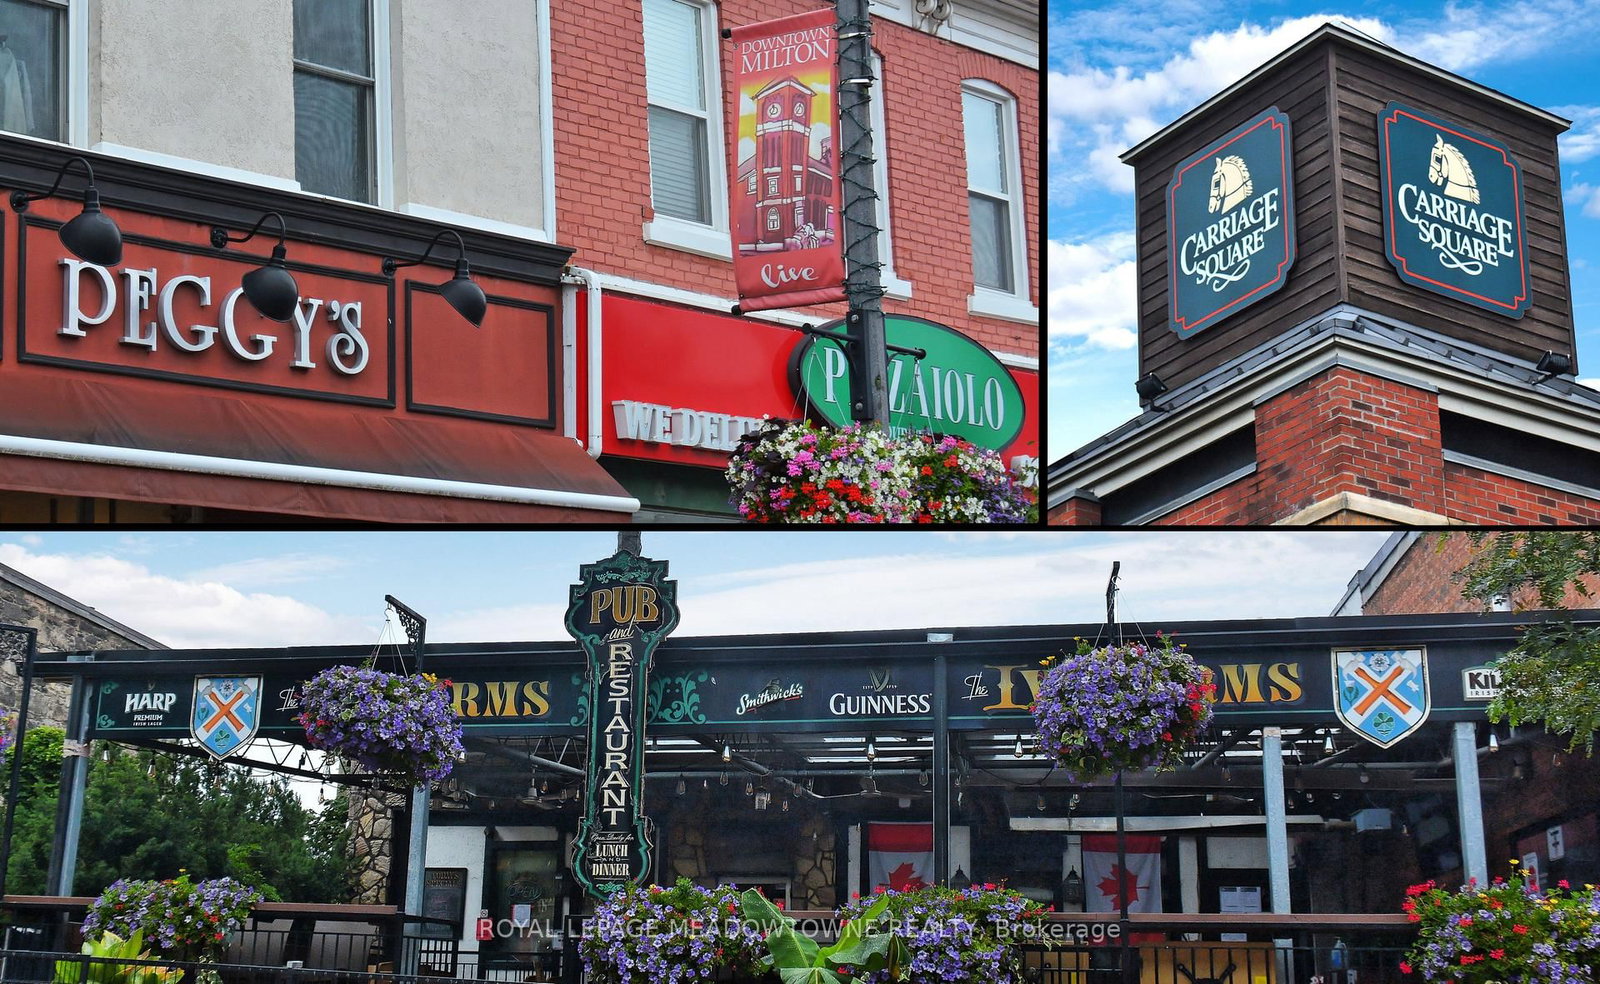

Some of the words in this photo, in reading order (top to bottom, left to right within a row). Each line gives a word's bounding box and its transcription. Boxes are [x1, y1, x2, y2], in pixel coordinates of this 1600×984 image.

[741, 39, 830, 74] MILTON
[742, 26, 830, 55] DOWNTOWN
[1181, 187, 1279, 275] CARRIAGE
[1398, 183, 1514, 258] CARRIAGE
[1196, 226, 1265, 292] SQUARE
[1418, 219, 1498, 275] SQUARE
[57, 258, 369, 375] PEGGY'S
[823, 347, 1004, 430] PZAIOLO
[612, 400, 672, 442] WE
[590, 585, 659, 624] PUB
[608, 614, 635, 643] and
[124, 692, 177, 714] HARP
[736, 683, 803, 716] Smithwick's
[829, 693, 931, 715] GUINNESS
[961, 671, 989, 701] The
[602, 642, 633, 826] RESTAURANT
[596, 844, 628, 857] LUNCH
[592, 863, 629, 876] DINNER
